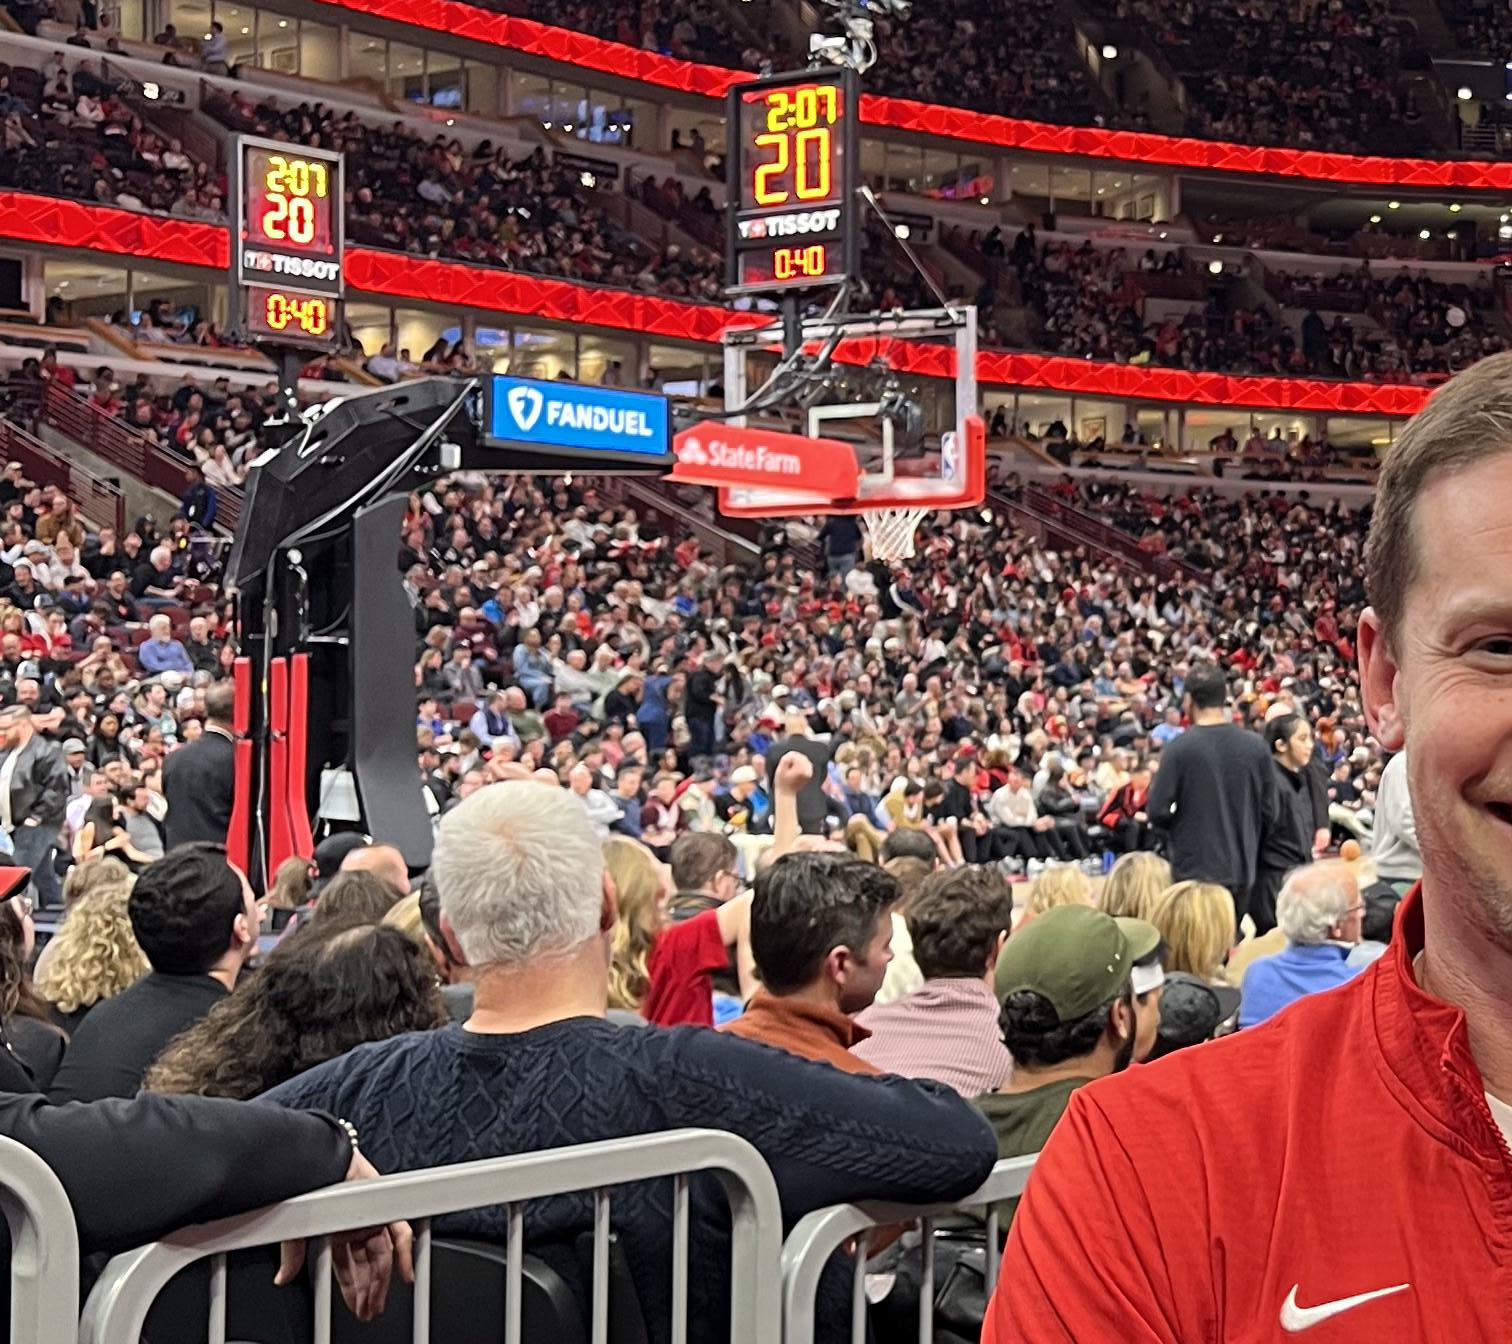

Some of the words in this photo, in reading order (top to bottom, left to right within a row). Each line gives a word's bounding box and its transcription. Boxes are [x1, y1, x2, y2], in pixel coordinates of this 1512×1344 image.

[767, 85, 837, 133] 2:07
[266, 155, 328, 199] 2:07
[755, 127, 831, 206] 20
[263, 192, 315, 245] 20
[766, 208, 841, 237] TISSOT
[272, 254, 340, 281] TISSOT
[774, 244, 825, 280] 0:40
[266, 293, 327, 336] 0:40
[546, 400, 653, 438] FANDUEL
